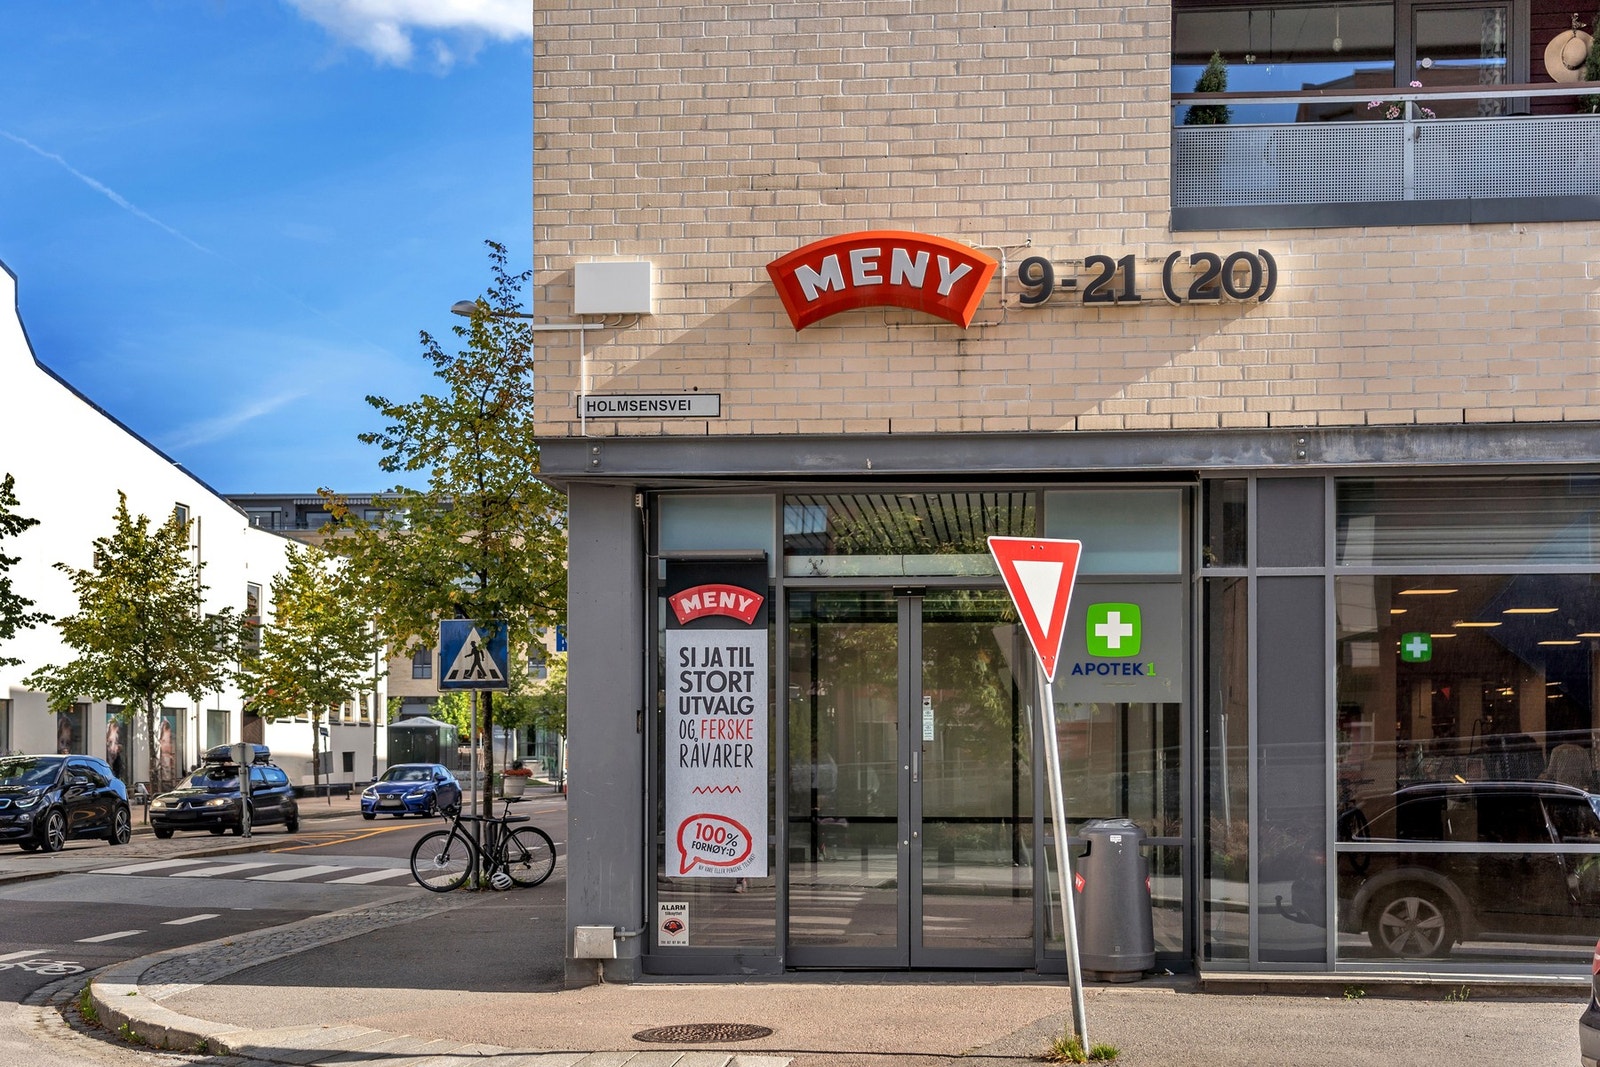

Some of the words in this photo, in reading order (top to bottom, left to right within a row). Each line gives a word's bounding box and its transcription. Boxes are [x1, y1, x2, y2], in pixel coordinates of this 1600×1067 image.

[793, 248, 973, 302] MENY
[1017, 253, 1142, 306] 9-21
[1161, 249, 1278, 306] (20)
[586, 399, 691, 412] HOLMSENSVEI
[680, 591, 754, 614] MENY
[679, 646, 696, 668] SI
[701, 646, 724, 668] JA
[725, 646, 755, 668] TIL
[1071, 662, 1144, 676] APOTEK
[1146, 662, 1157, 677] 1
[679, 670, 755, 693] STORT
[679, 696, 755, 715] UTVALG
[679, 719, 696, 740] OG
[701, 719, 754, 740] FERSKE
[679, 737, 754, 769] RÅVARER
[696, 822, 739, 847] 100%
[691, 840, 736, 857] FORNØY:D
